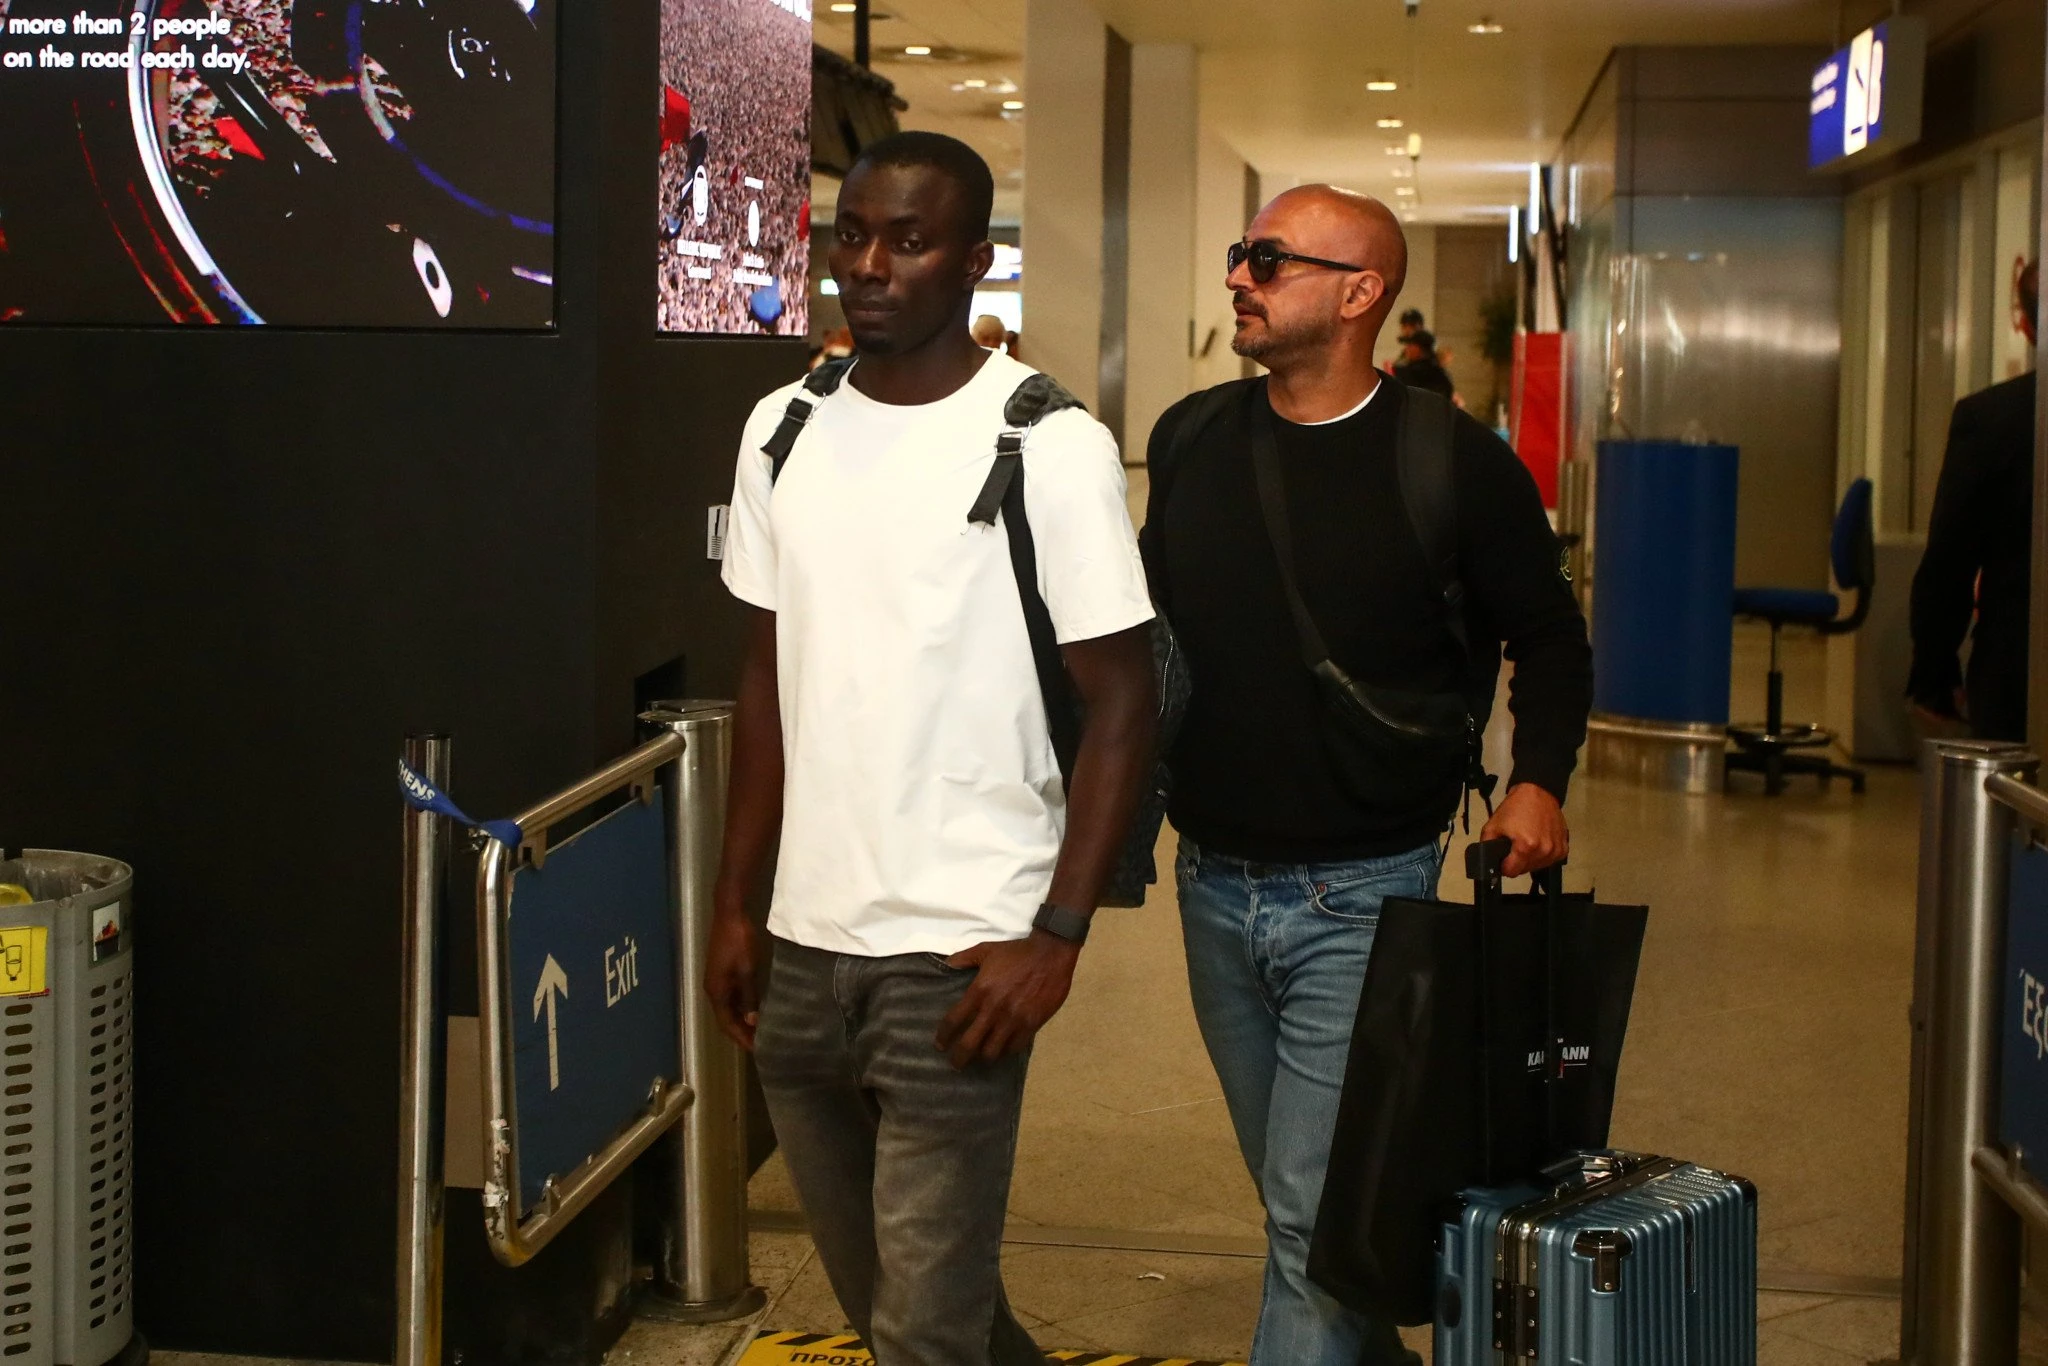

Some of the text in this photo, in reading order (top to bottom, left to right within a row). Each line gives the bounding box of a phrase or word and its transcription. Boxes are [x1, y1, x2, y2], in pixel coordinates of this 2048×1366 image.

[9, 10, 231, 41] more than 2 people
[3, 43, 251, 75] on the road each day.
[605, 935, 639, 1009] Exit
